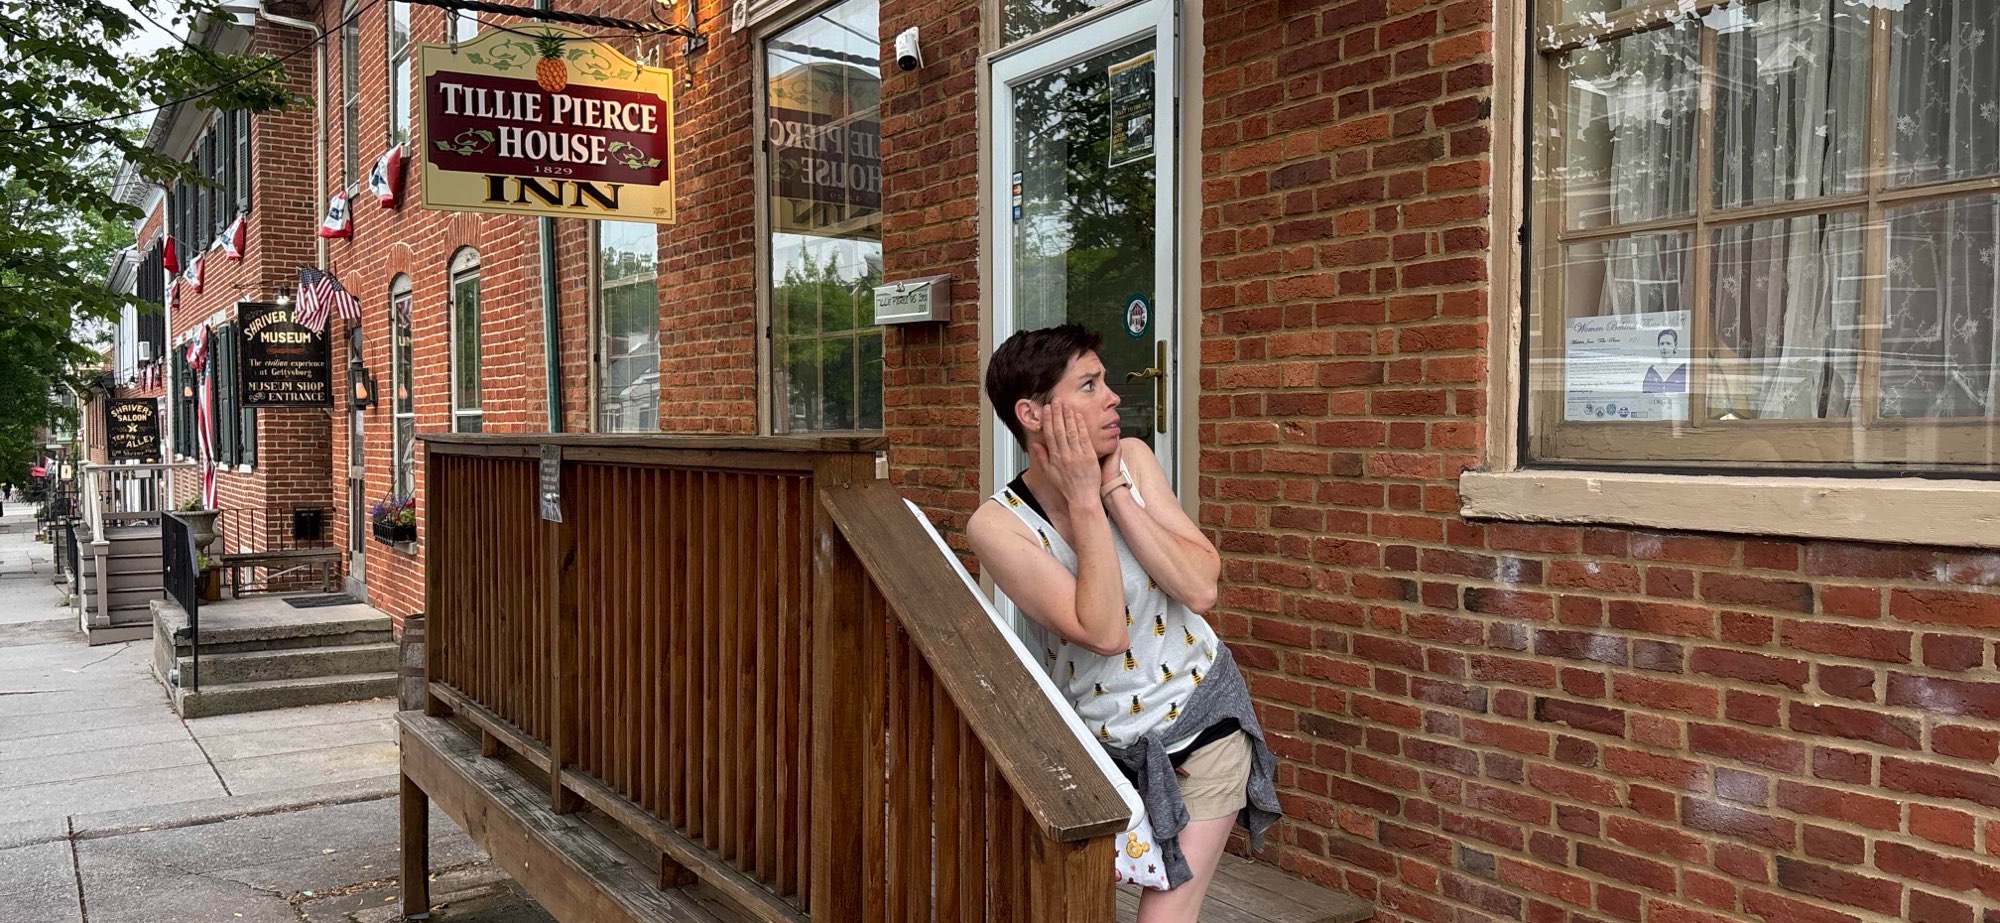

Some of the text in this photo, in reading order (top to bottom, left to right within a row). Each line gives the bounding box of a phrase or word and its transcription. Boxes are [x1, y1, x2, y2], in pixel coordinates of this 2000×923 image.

[440, 82, 658, 134] TILLIE PIERCE
[498, 126, 608, 165] HOUSE
[533, 165, 573, 176] 1829
[482, 174, 624, 212] INN
[243, 310, 288, 341] SHRIVER
[1573, 321, 1603, 333] Women
[260, 331, 312, 344] MUSEUM
[290, 359, 325, 369] experience
[271, 368, 312, 378] Gettysburg
[248, 381, 325, 391] MUSEUM SHOP
[268, 392, 325, 402] ENTRANCE
[126, 435, 155, 448] ALLEY
